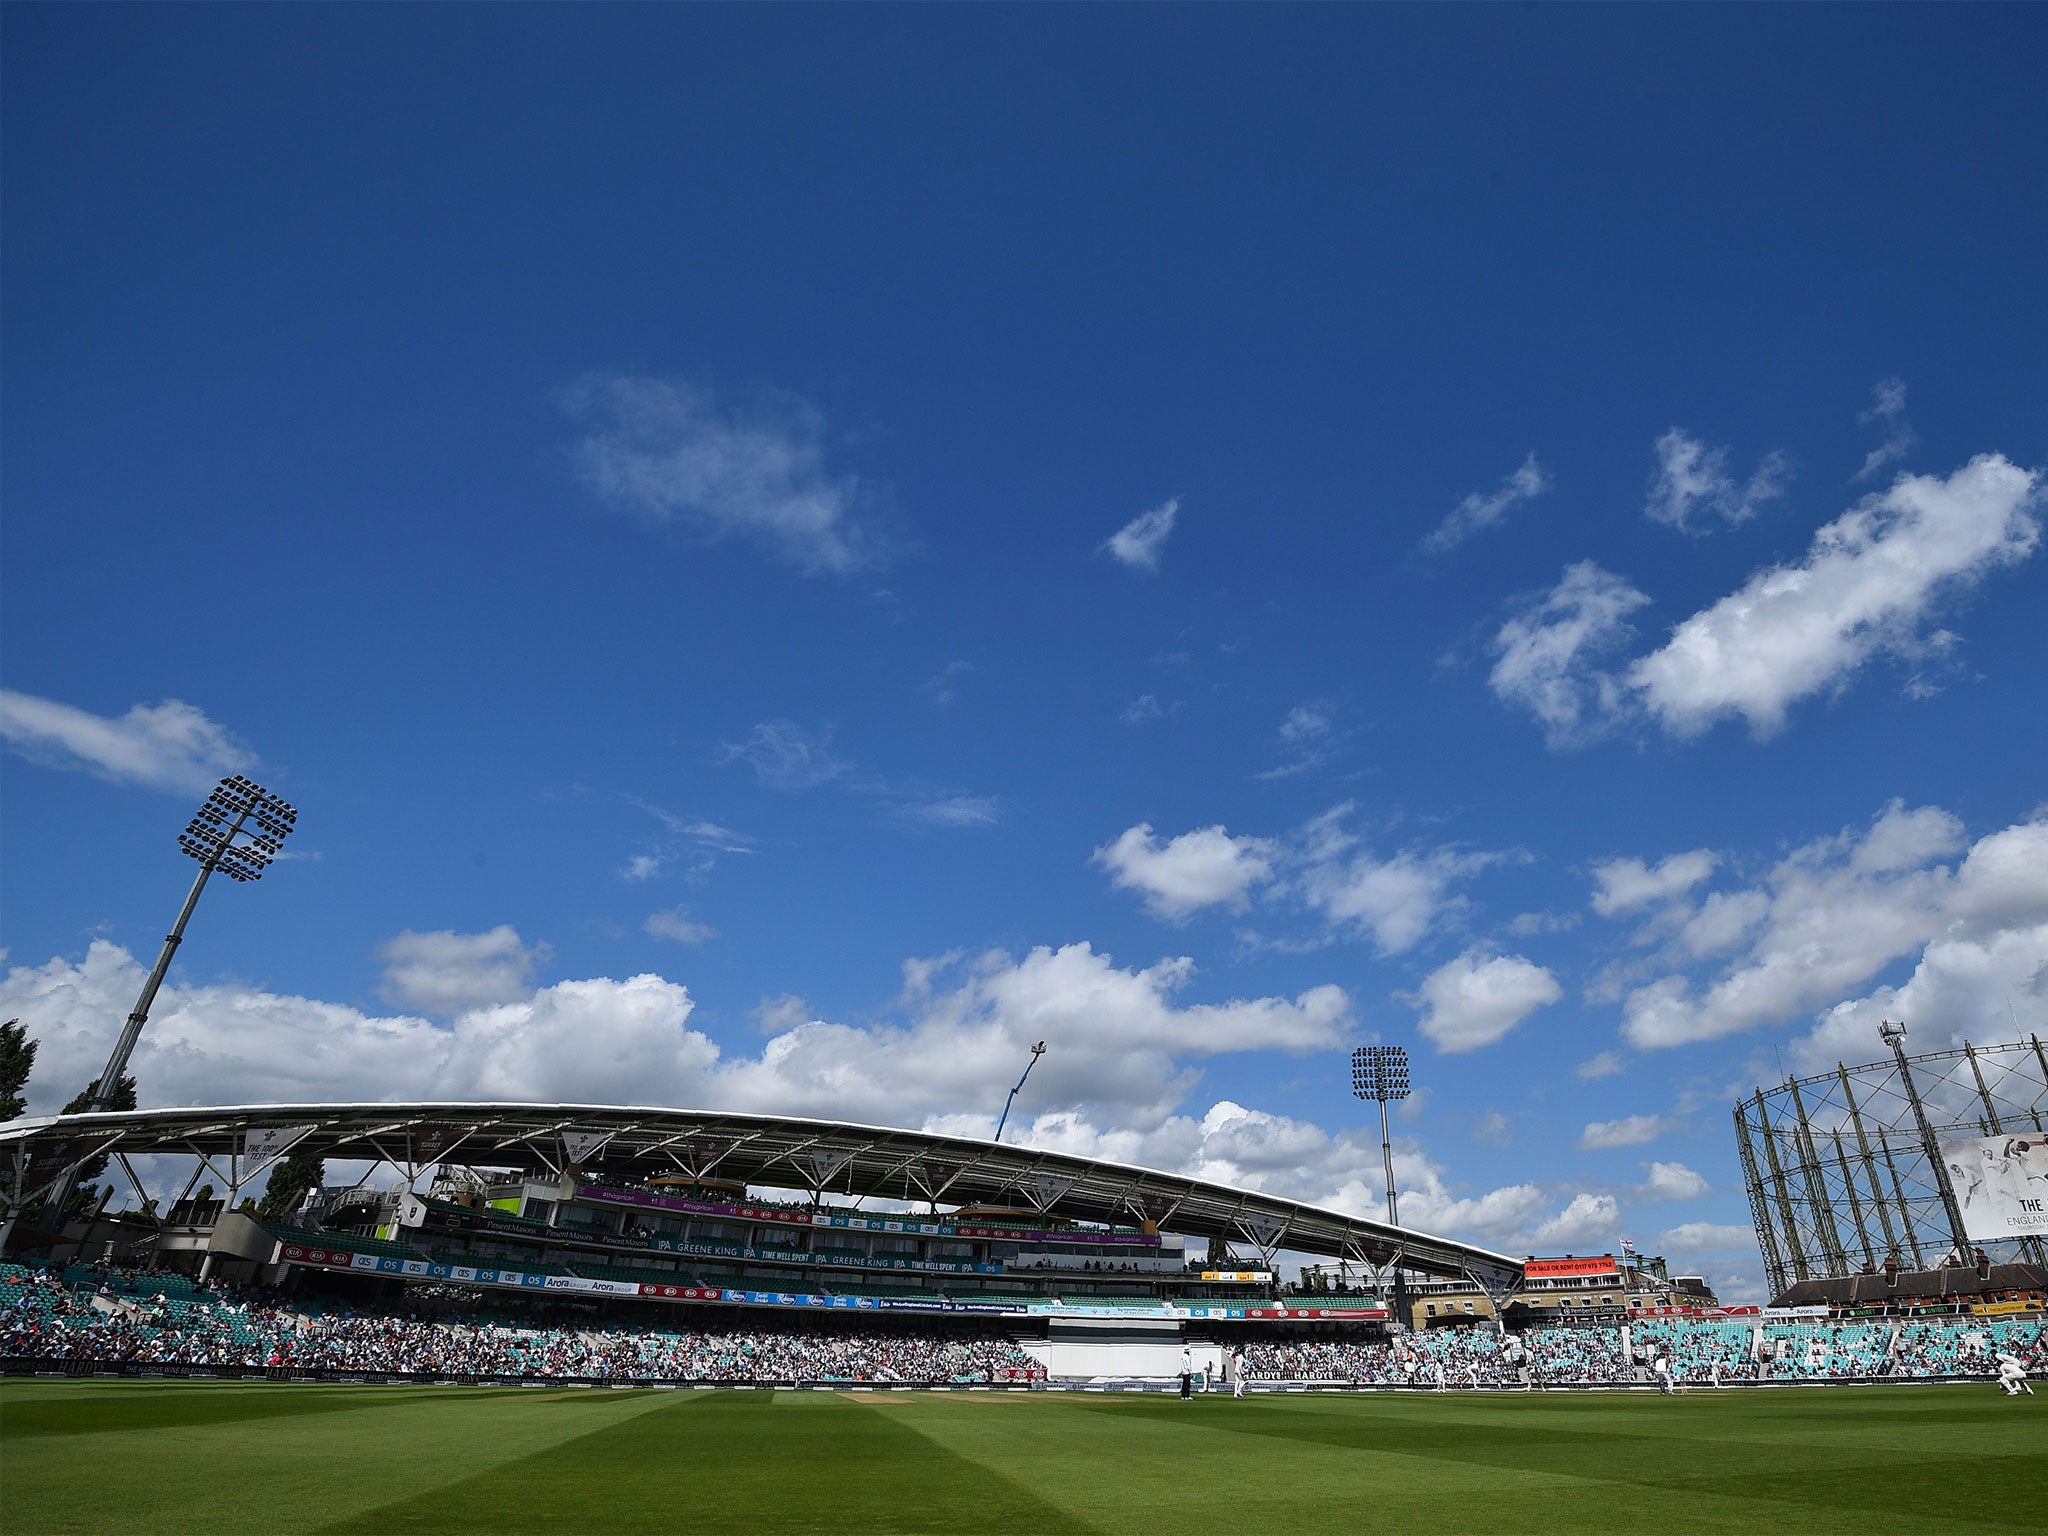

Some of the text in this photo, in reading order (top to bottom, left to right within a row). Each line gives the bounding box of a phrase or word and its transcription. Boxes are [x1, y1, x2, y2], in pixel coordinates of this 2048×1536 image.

[247, 1144, 261, 1152] THE
[420, 1141, 441, 1149] SURREY
[250, 1152, 267, 1160] TEST
[37, 1158, 69, 1167] SURREY
[602, 1192, 635, 1202] #thisgirlcan
[683, 1203, 714, 1212] #thisgirlcan
[2019, 1199, 2044, 1212] THE
[487, 1220, 537, 1235] Pinsent Masons
[545, 1228, 594, 1242] Pinsent Masons
[602, 1235, 649, 1248] Pinsent Masons
[658, 1240, 738, 1257] IPA GREENE KING
[743, 1249, 810, 1262] IPA TIME WELL SPENT
[815, 1254, 888, 1267] IPA GREENE KING
[894, 1259, 956, 1271] IPA TIME WELL SPENT
[961, 1263, 974, 1273] IPA
[546, 1278, 569, 1288] Arora
[591, 1282, 614, 1292] Arora
[1570, 1305, 1624, 1315] Pemberton Greenish
[1796, 1308, 1813, 1316] Arora
[1926, 1307, 1949, 1315] UNIBET
[59, 1361, 106, 1375] HARDYS
[125, 1365, 139, 1373] THE
[141, 1366, 163, 1374] HARDYS
[181, 1367, 211, 1376] SELECTION
[264, 1368, 306, 1379] HARDYS
[1294, 1371, 1333, 1380] HARDYS
[443, 1374, 481, 1384] HARDYS
